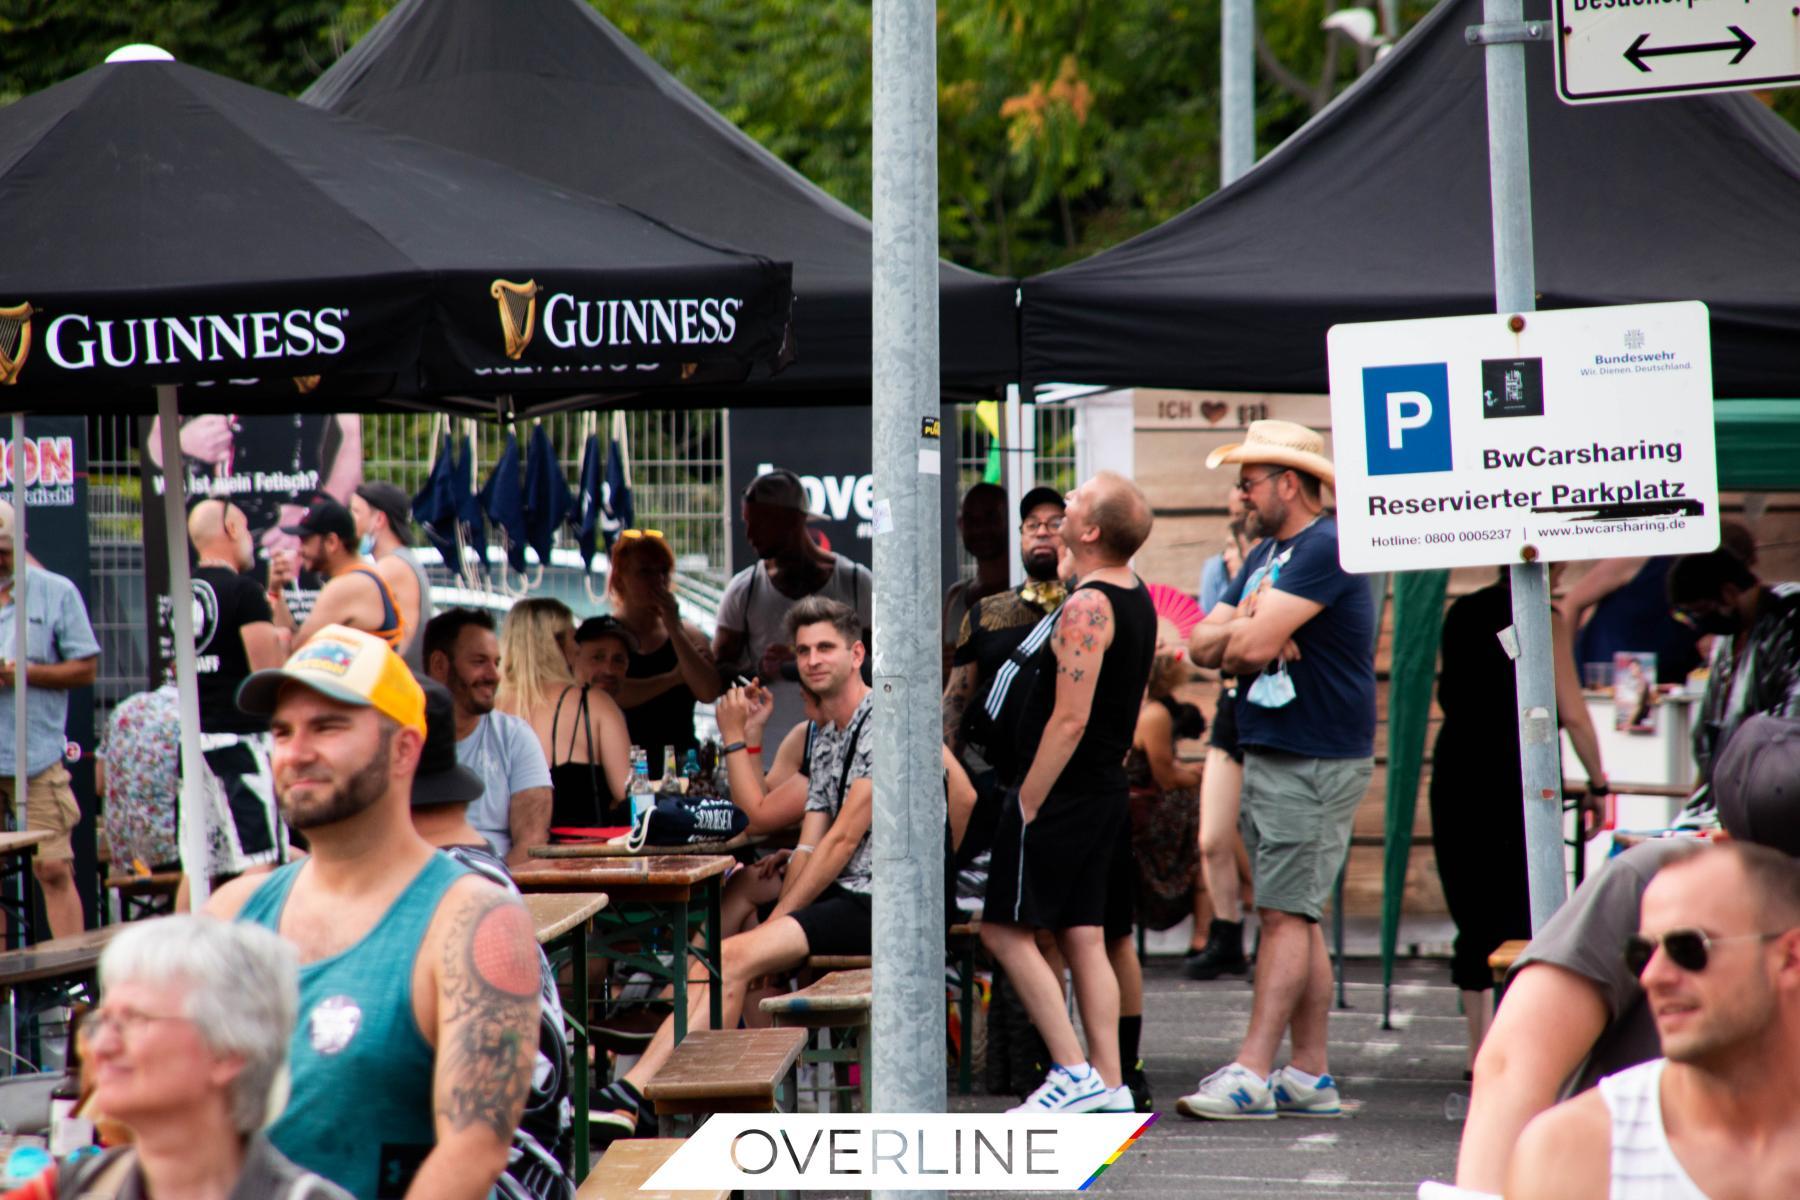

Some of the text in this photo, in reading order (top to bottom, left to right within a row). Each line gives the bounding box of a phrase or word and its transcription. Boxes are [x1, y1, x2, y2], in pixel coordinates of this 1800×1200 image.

[544, 293, 738, 348] GUINNESS
[45, 307, 346, 369] GUINNESS
[1595, 350, 1676, 365] Bundeswehr
[1600, 365, 1632, 376] Dienen.
[1386, 391, 1433, 449] P
[1483, 439, 1682, 470] BwCarsharing
[1369, 479, 1686, 516] Reservierter Parkplatz
[1371, 519, 1686, 547] Hotline: 0800 0005237 www.bwcarsharing.de
